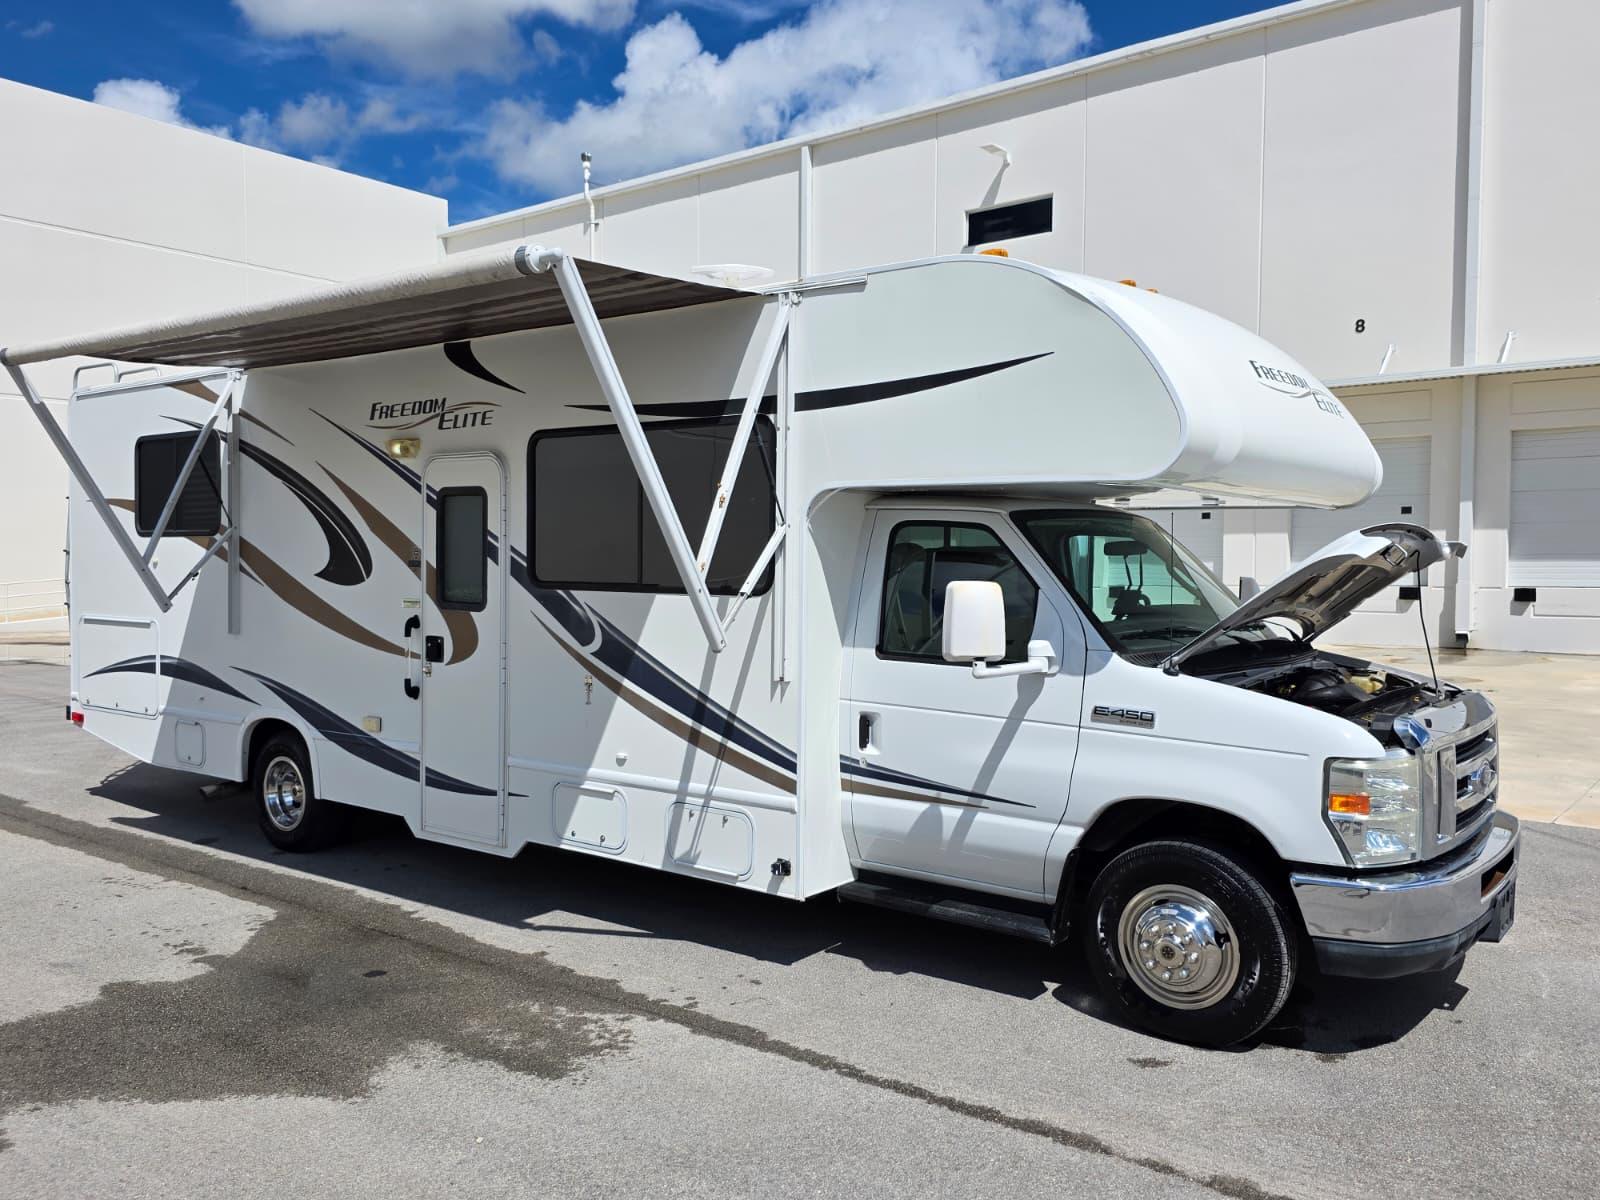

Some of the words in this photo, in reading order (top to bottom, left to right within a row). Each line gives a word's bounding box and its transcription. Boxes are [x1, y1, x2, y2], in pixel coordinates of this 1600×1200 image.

[1355, 319, 1365, 333] 8
[1248, 360, 1311, 389] FREEDOM
[369, 397, 447, 420] FREEDOM
[1312, 391, 1344, 419] ELITE
[438, 410, 494, 430] ELITE
[1094, 705, 1155, 722] E-450
